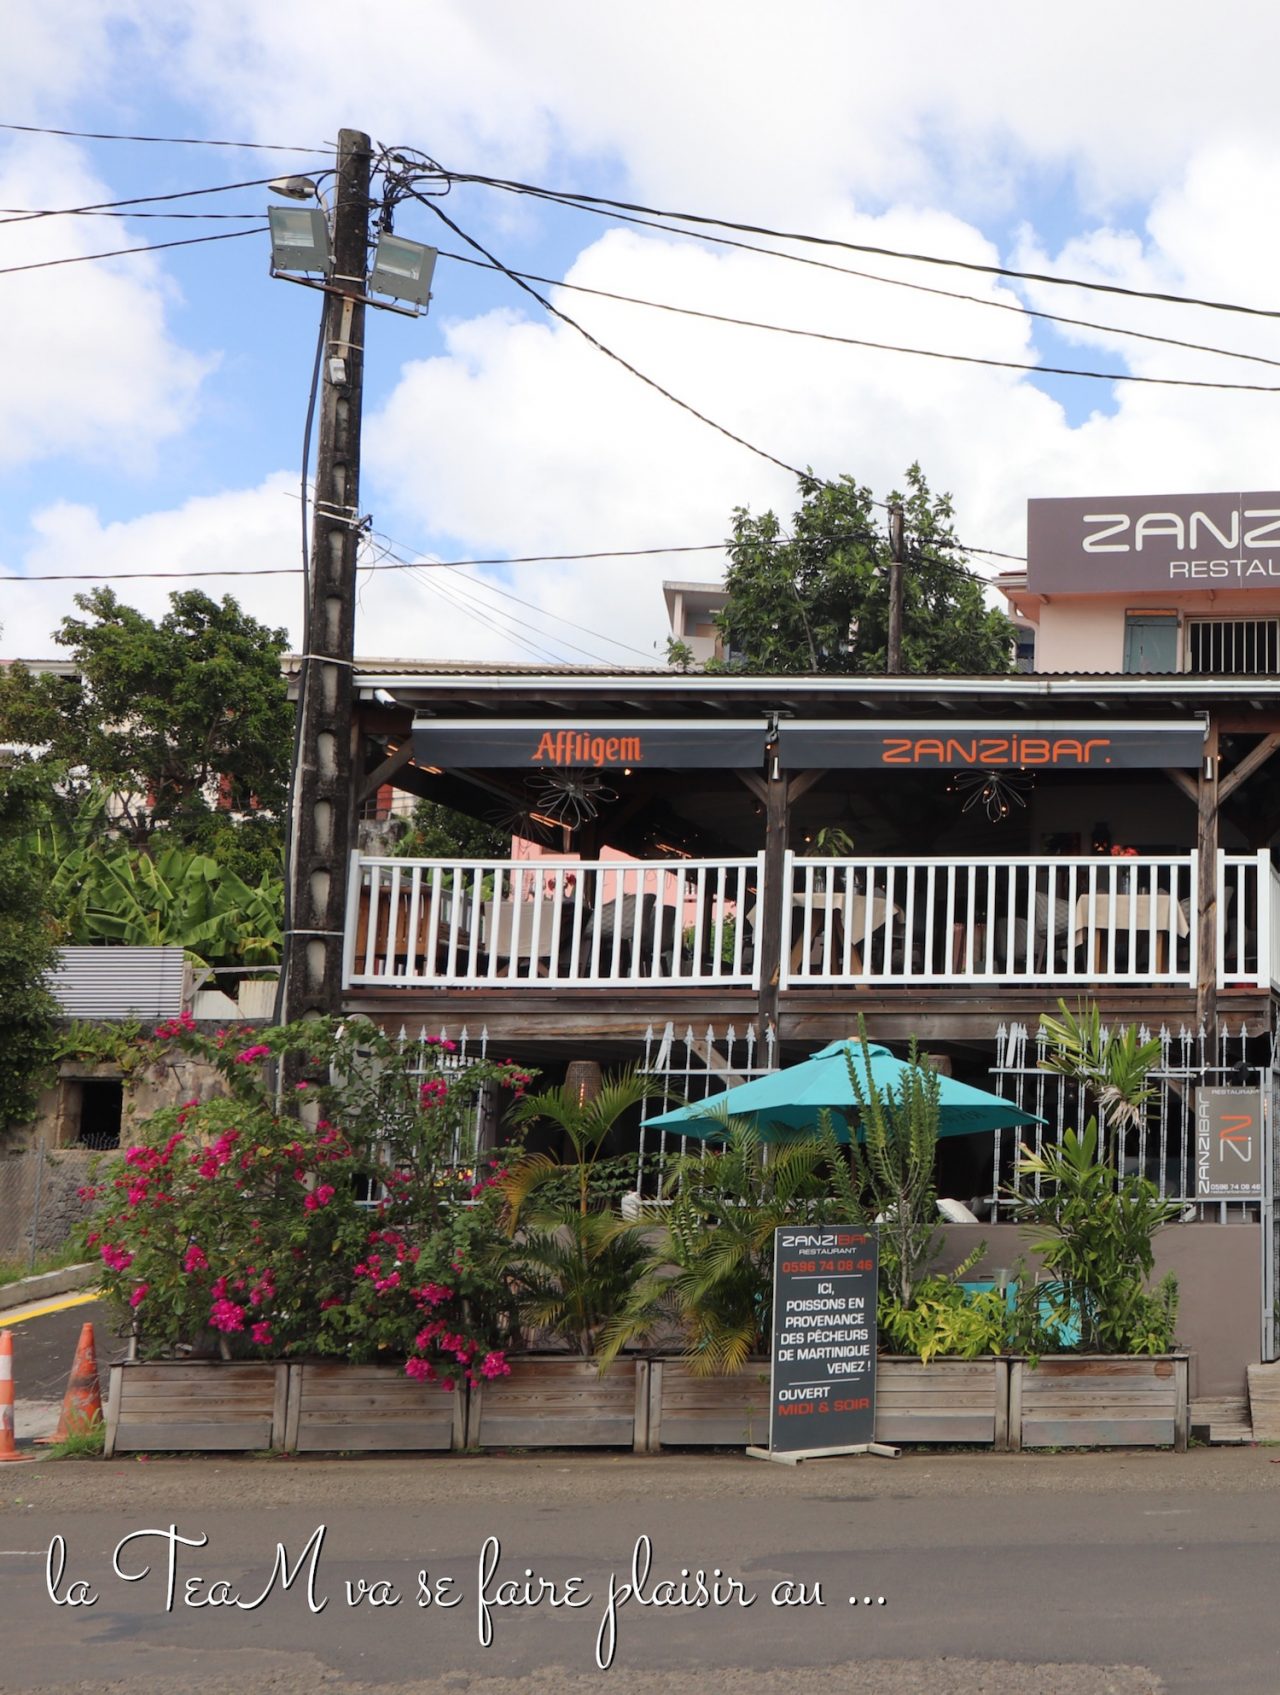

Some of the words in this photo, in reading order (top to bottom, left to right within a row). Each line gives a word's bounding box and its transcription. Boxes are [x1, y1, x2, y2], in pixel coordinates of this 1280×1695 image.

[531, 731, 643, 767] Affligem
[798, 1247, 857, 1255] RESTAURANT
[782, 1261, 816, 1273] 0596
[819, 1260, 834, 1271] 74
[837, 1260, 853, 1271] 08
[857, 1259, 873, 1270] 46
[817, 1282, 835, 1295] ICI,
[786, 1298, 846, 1313] POISSONS
[848, 1297, 865, 1310] EN
[785, 1313, 865, 1328] PROVENANCE
[780, 1331, 804, 1345] DES
[807, 1328, 868, 1343] PÊCHEURS
[778, 1349, 794, 1362] DE
[797, 1344, 870, 1360] MARTINIQUE
[827, 1361, 865, 1375] VENEZ
[867, 1360, 871, 1372] !
[778, 1386, 831, 1401] OUVERT
[778, 1402, 813, 1416] MIDI
[818, 1401, 830, 1413] &
[833, 1398, 869, 1411] SOIR
